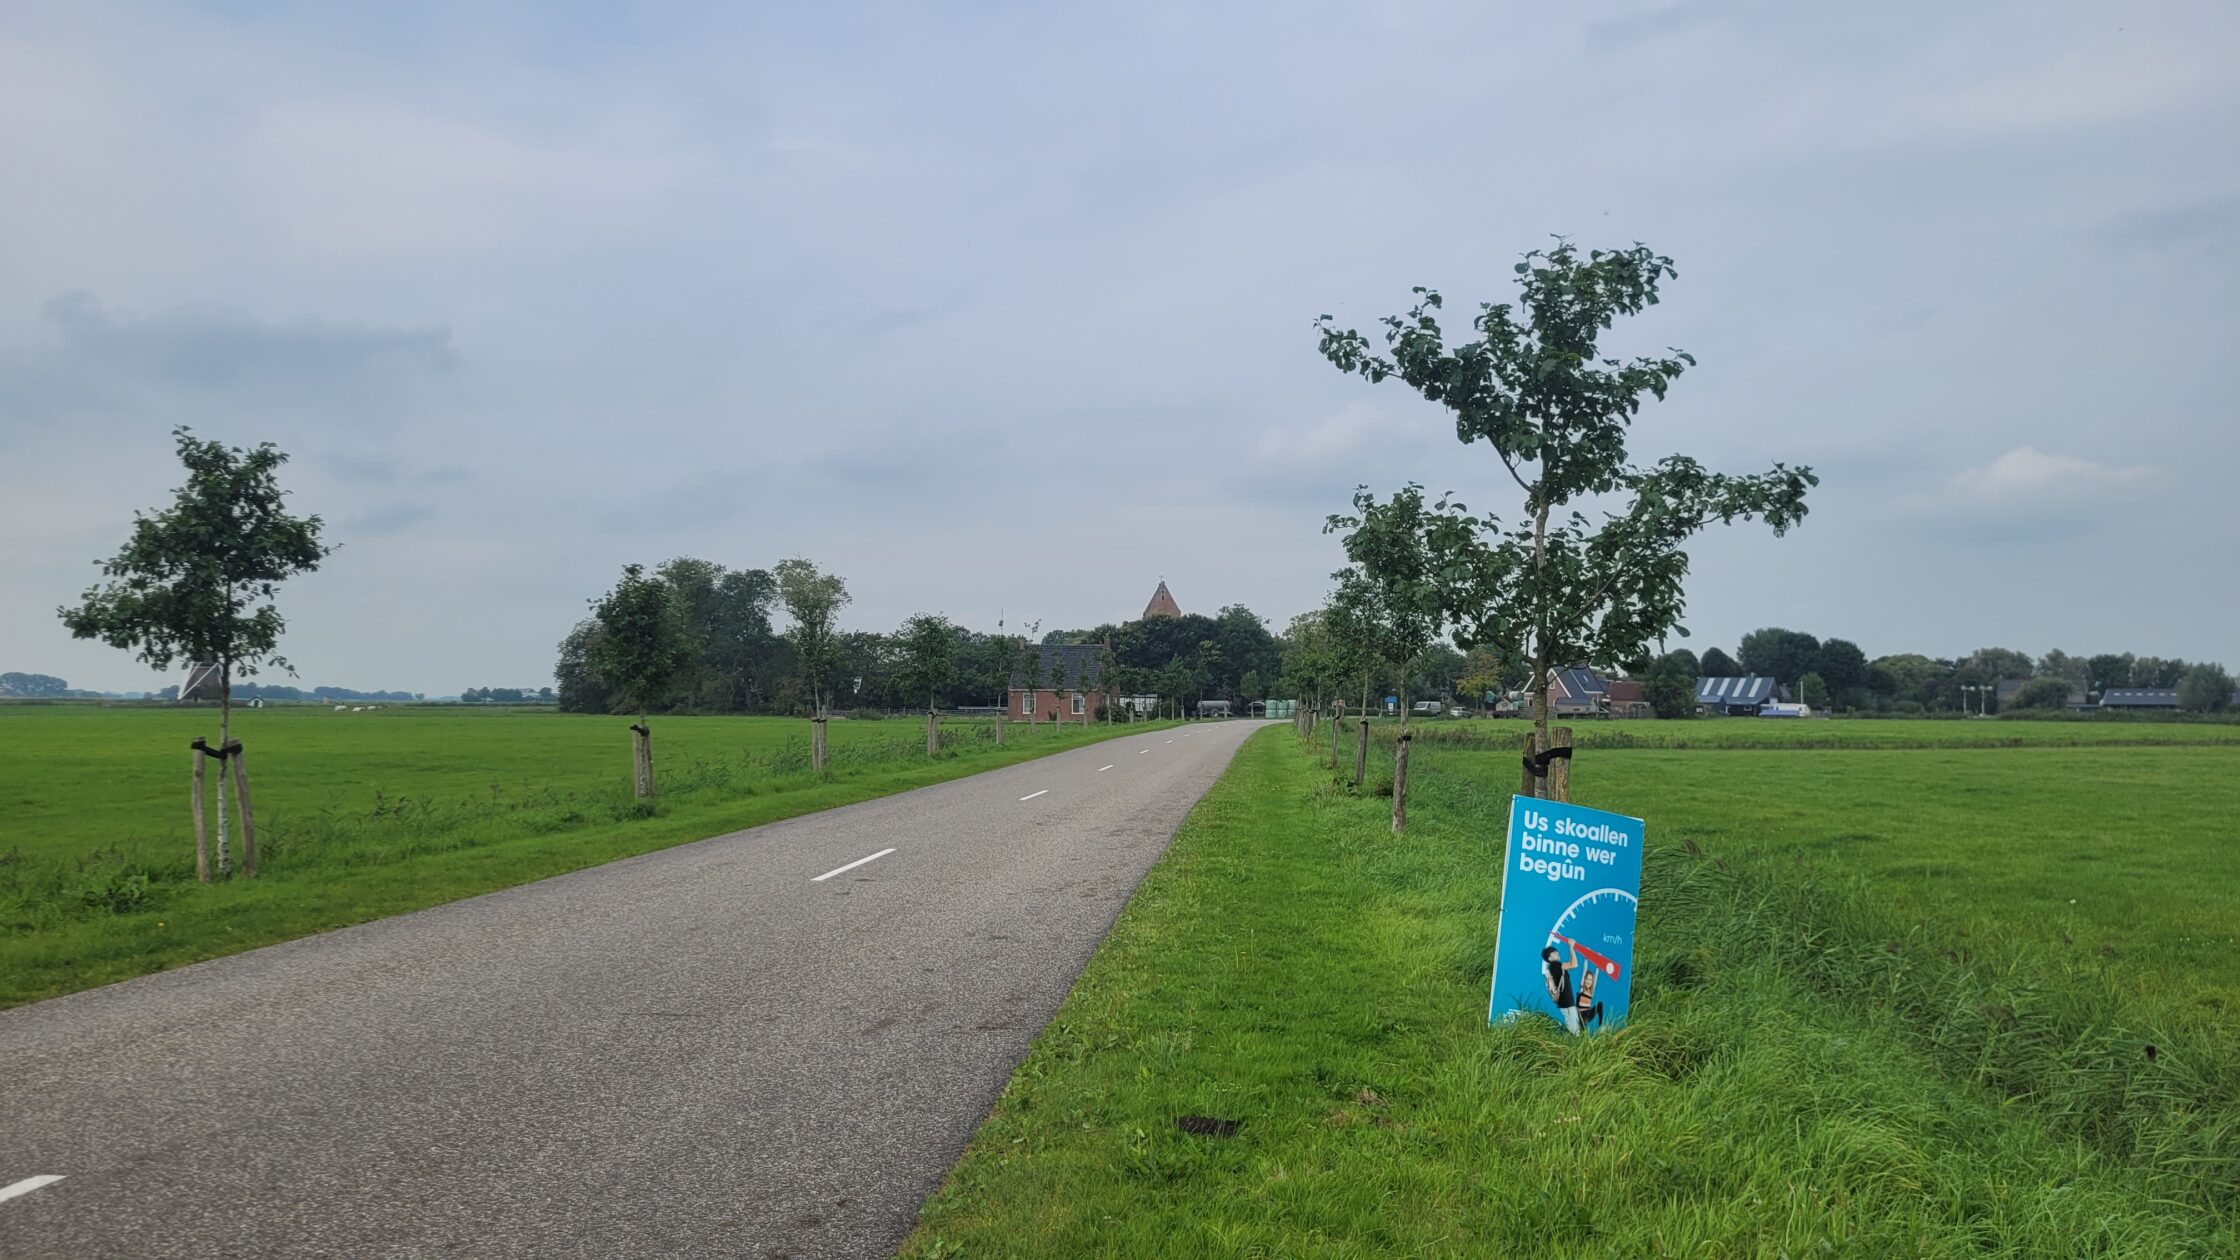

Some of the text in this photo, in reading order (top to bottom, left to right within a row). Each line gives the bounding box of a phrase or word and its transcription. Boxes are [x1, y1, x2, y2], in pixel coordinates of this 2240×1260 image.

[1524, 810, 1628, 848] Us skoallen
[1521, 831, 1616, 865] binne wer
[1519, 852, 1585, 881] begûn
[1603, 932, 1623, 945] km/h
